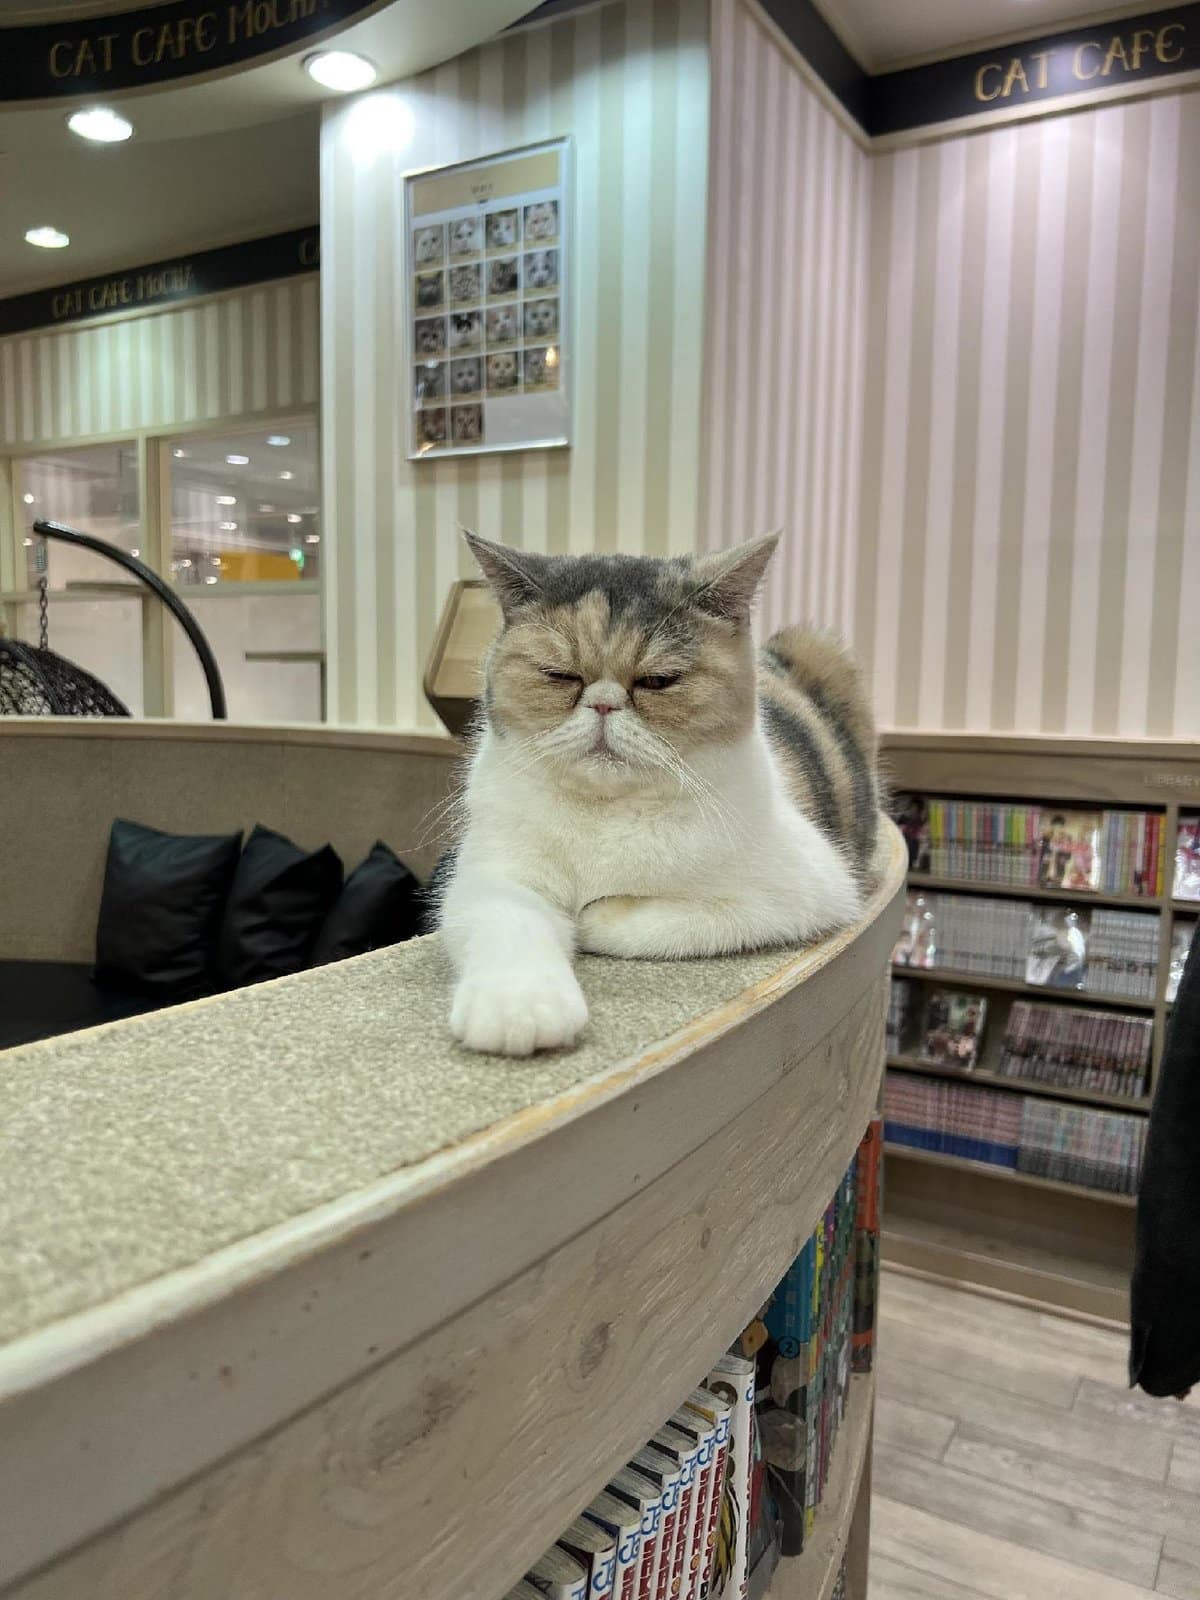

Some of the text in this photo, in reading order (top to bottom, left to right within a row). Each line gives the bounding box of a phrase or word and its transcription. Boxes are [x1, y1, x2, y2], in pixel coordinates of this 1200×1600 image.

[50, 33, 120, 79] CAT
[131, 13, 217, 67] CAFE
[975, 23, 1186, 101] CAT CAFE
